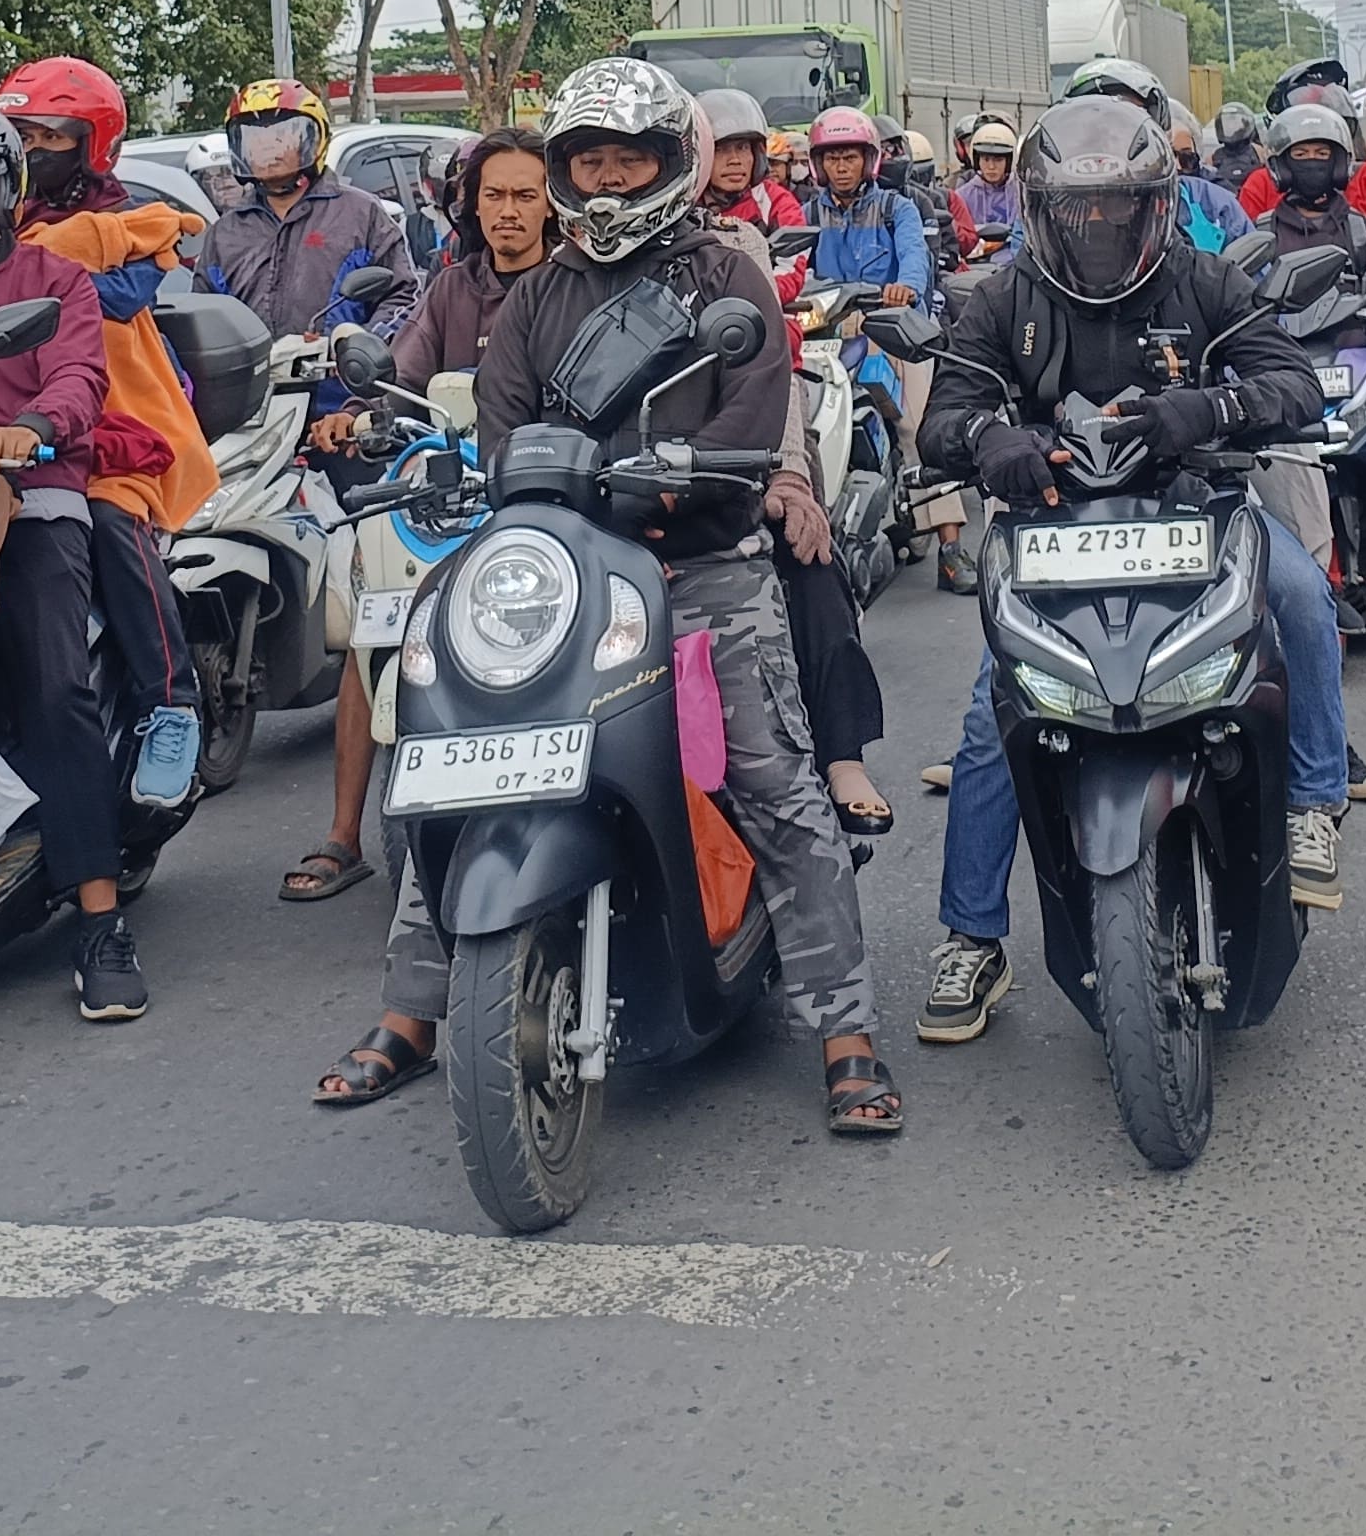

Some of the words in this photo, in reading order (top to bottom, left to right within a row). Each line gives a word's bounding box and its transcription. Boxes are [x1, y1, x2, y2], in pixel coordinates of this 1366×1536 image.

[1021, 321, 1035, 356] torch
[512, 446, 555, 457] HONDA
[1027, 533, 1061, 554] AA
[1078, 528, 1146, 552] 2737
[1169, 526, 1202, 548] DJ
[362, 598, 374, 620] E
[407, 746, 424, 771] B
[443, 737, 516, 766] 5366
[532, 728, 584, 758] TSU
